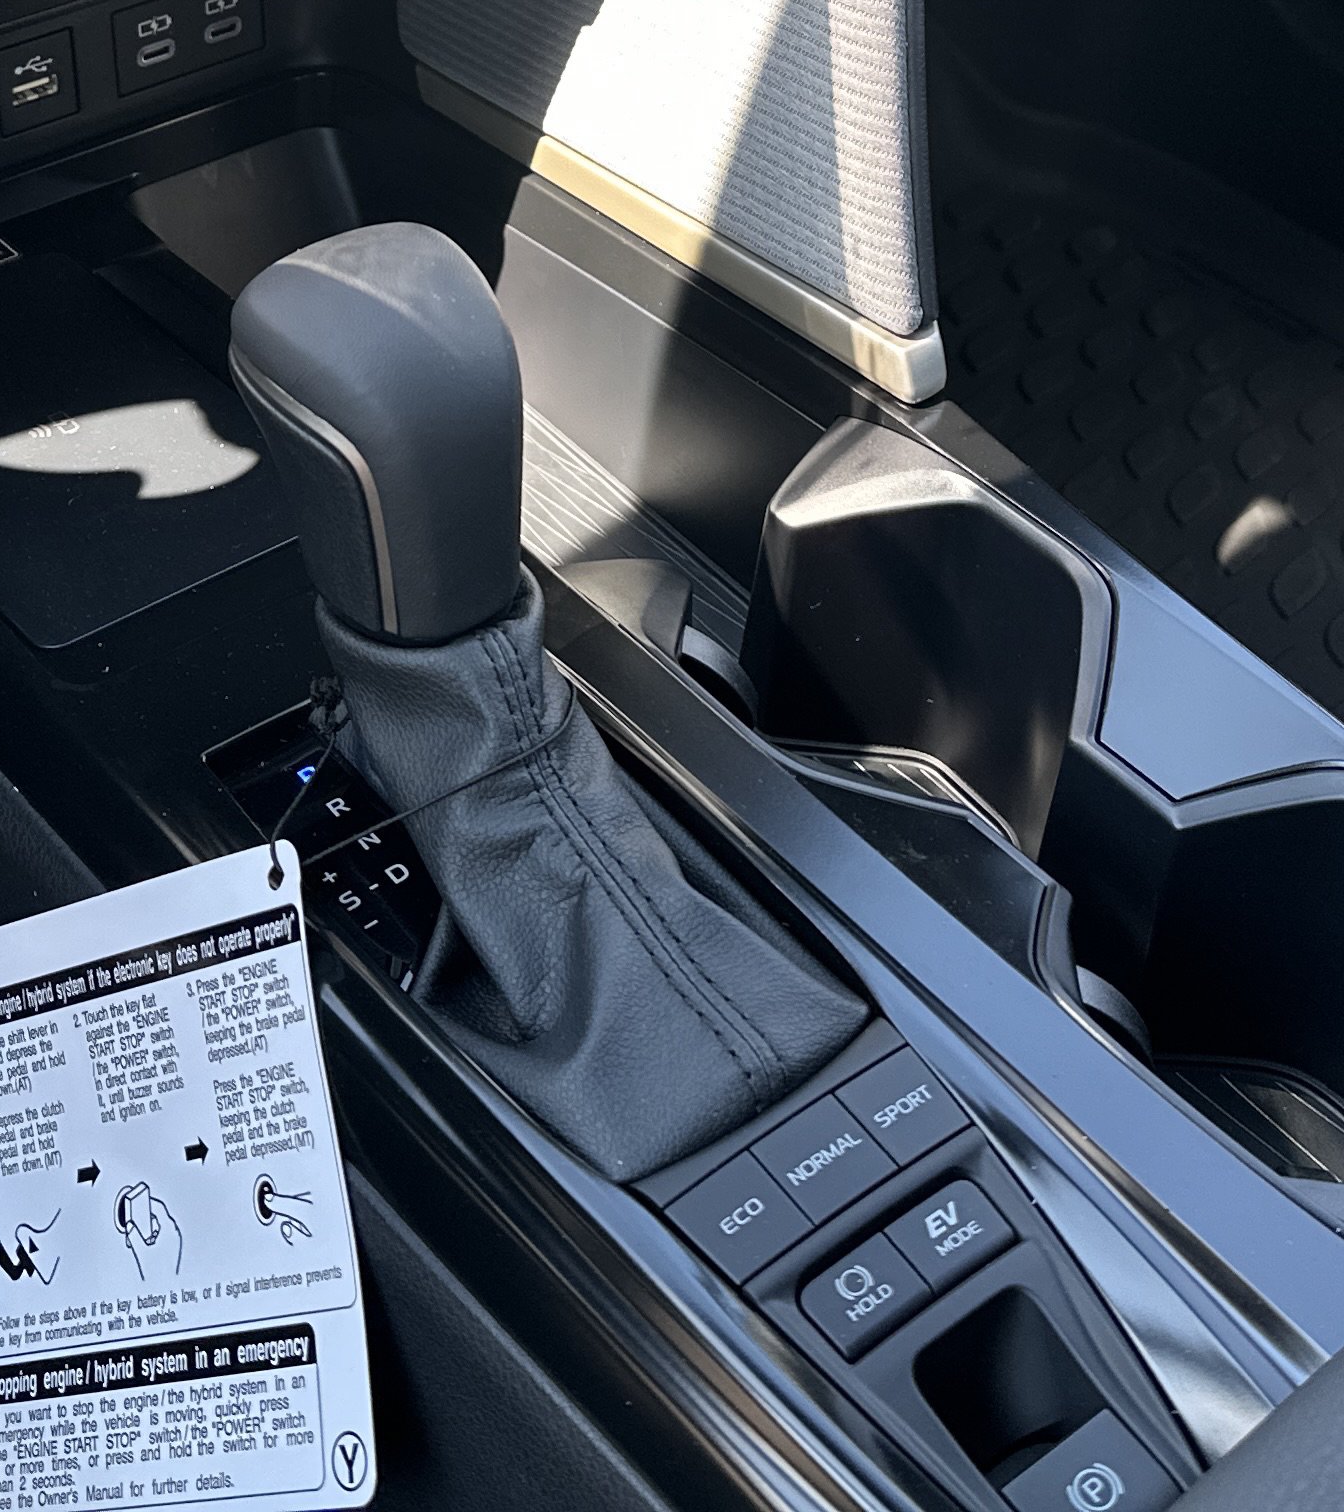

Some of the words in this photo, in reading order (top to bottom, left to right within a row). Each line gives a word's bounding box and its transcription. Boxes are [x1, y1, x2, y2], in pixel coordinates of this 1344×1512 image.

[325, 797, 351, 817] R
[358, 833, 382, 851] N
[384, 864, 410, 884] D
[339, 890, 361, 911] S
[56, 977, 86, 1005] system
[87, 970, 95, 990] if
[97, 967, 112, 988] the
[114, 954, 154, 984] electronic
[156, 950, 173, 978] key
[177, 942, 198, 966] does
[201, 936, 216, 958] not
[218, 927, 252, 955] operate
[873, 1084, 933, 1129] SPORT
[786, 1132, 863, 1187] NORMAL
[719, 1197, 765, 1235] ECO
[924, 1201, 959, 1239] EV
[935, 1219, 985, 1257] MODE
[846, 1283, 895, 1322] HOLD
[141, 1352, 188, 1381] system
[195, 1346, 208, 1369] in
[214, 1347, 231, 1367] an
[237, 1336, 309, 1365] emergency
[5, 1411, 22, 1428] you
[29, 1404, 51, 1421] want
[57, 1404, 67, 1418] to
[72, 1400, 94, 1418] stop
[100, 1397, 116, 1413] the
[190, 1382, 223, 1405] hybrid
[229, 1379, 267, 1397] system
[275, 1375, 285, 1391] in
[291, 1374, 306, 1389] an
[50, 1420, 75, 1437] while
[81, 1418, 97, 1434] the
[104, 1413, 140, 1431] vehicle
[150, 1408, 159, 1425] is
[165, 1405, 207, 1425] moving,
[215, 1399, 251, 1419] quickly
[260, 1396, 290, 1415] press
[63, 1435, 99, 1454] START
[272, 1411, 306, 1431] switch
[5, 1464, 15, 1476] or
[19, 1460, 44, 1474] more
[52, 1455, 81, 1471] times,
[88, 1454, 99, 1468] or
[106, 1451, 134, 1470] press
[140, 1442, 161, 1461] and
[169, 1439, 192, 1459] hold
[197, 1437, 215, 1455] the
[223, 1434, 256, 1453] switch
[263, 1431, 278, 1449] for
[286, 1430, 314, 1445] more
[339, 1443, 359, 1483] Y
[17, 1493, 33, 1509] the
[37, 1488, 78, 1506] Owner's
[86, 1482, 123, 1501] Manual
[130, 1480, 144, 1497] for
[151, 1476, 188, 1496] further
[196, 1472, 235, 1491] details.
[19, 1476, 26, 1491] 2
[32, 1472, 75, 1489] seconds.
